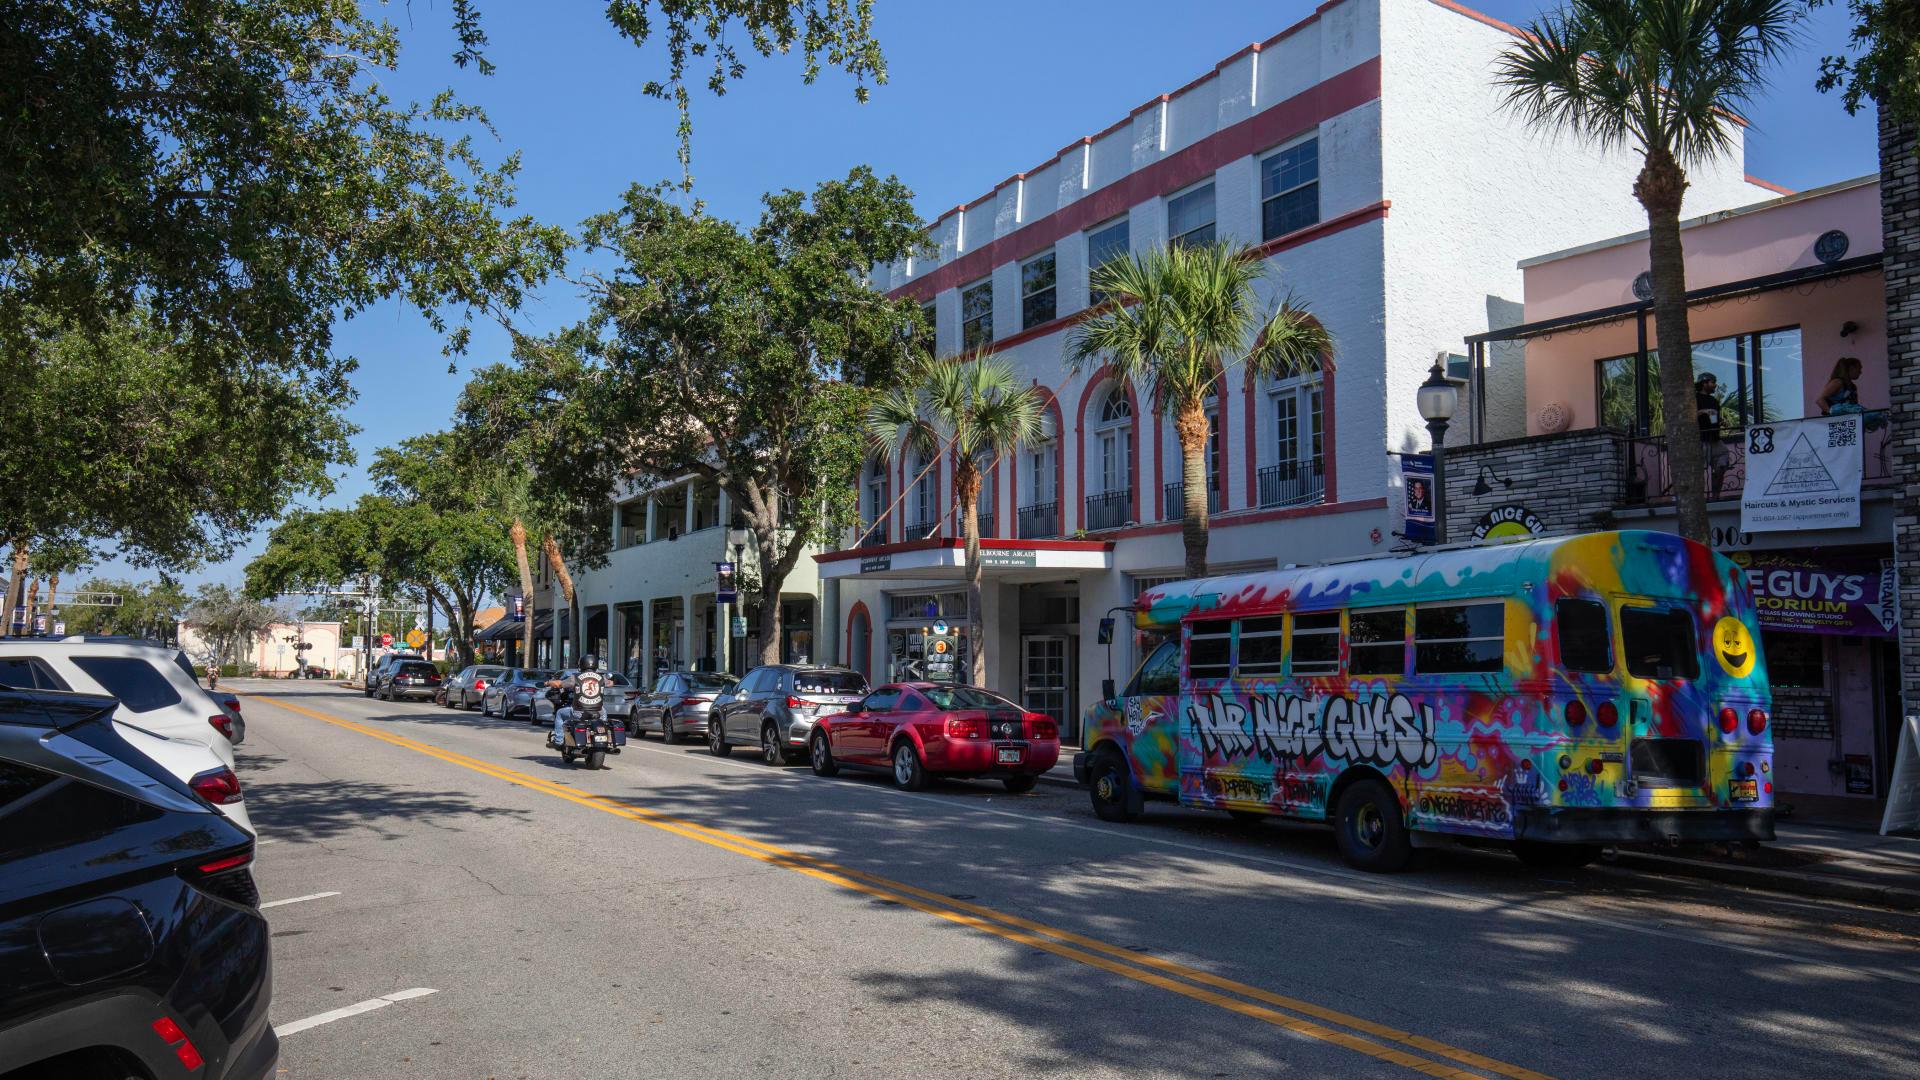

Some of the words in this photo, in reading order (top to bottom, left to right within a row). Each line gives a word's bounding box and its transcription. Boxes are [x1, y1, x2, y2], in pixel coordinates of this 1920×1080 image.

[1788, 498, 1817, 508] Mystic
[1818, 496, 1856, 505] Services
[1768, 569, 1865, 600] GUYS
[1882, 559, 1895, 626] ENTRANCE
[1755, 597, 1847, 613] PORIUM
[1781, 611, 1816, 619] BLOWING
[1195, 694, 1253, 760] MR
[1253, 692, 1325, 763] NICE
[1324, 692, 1437, 767] GUYS!
